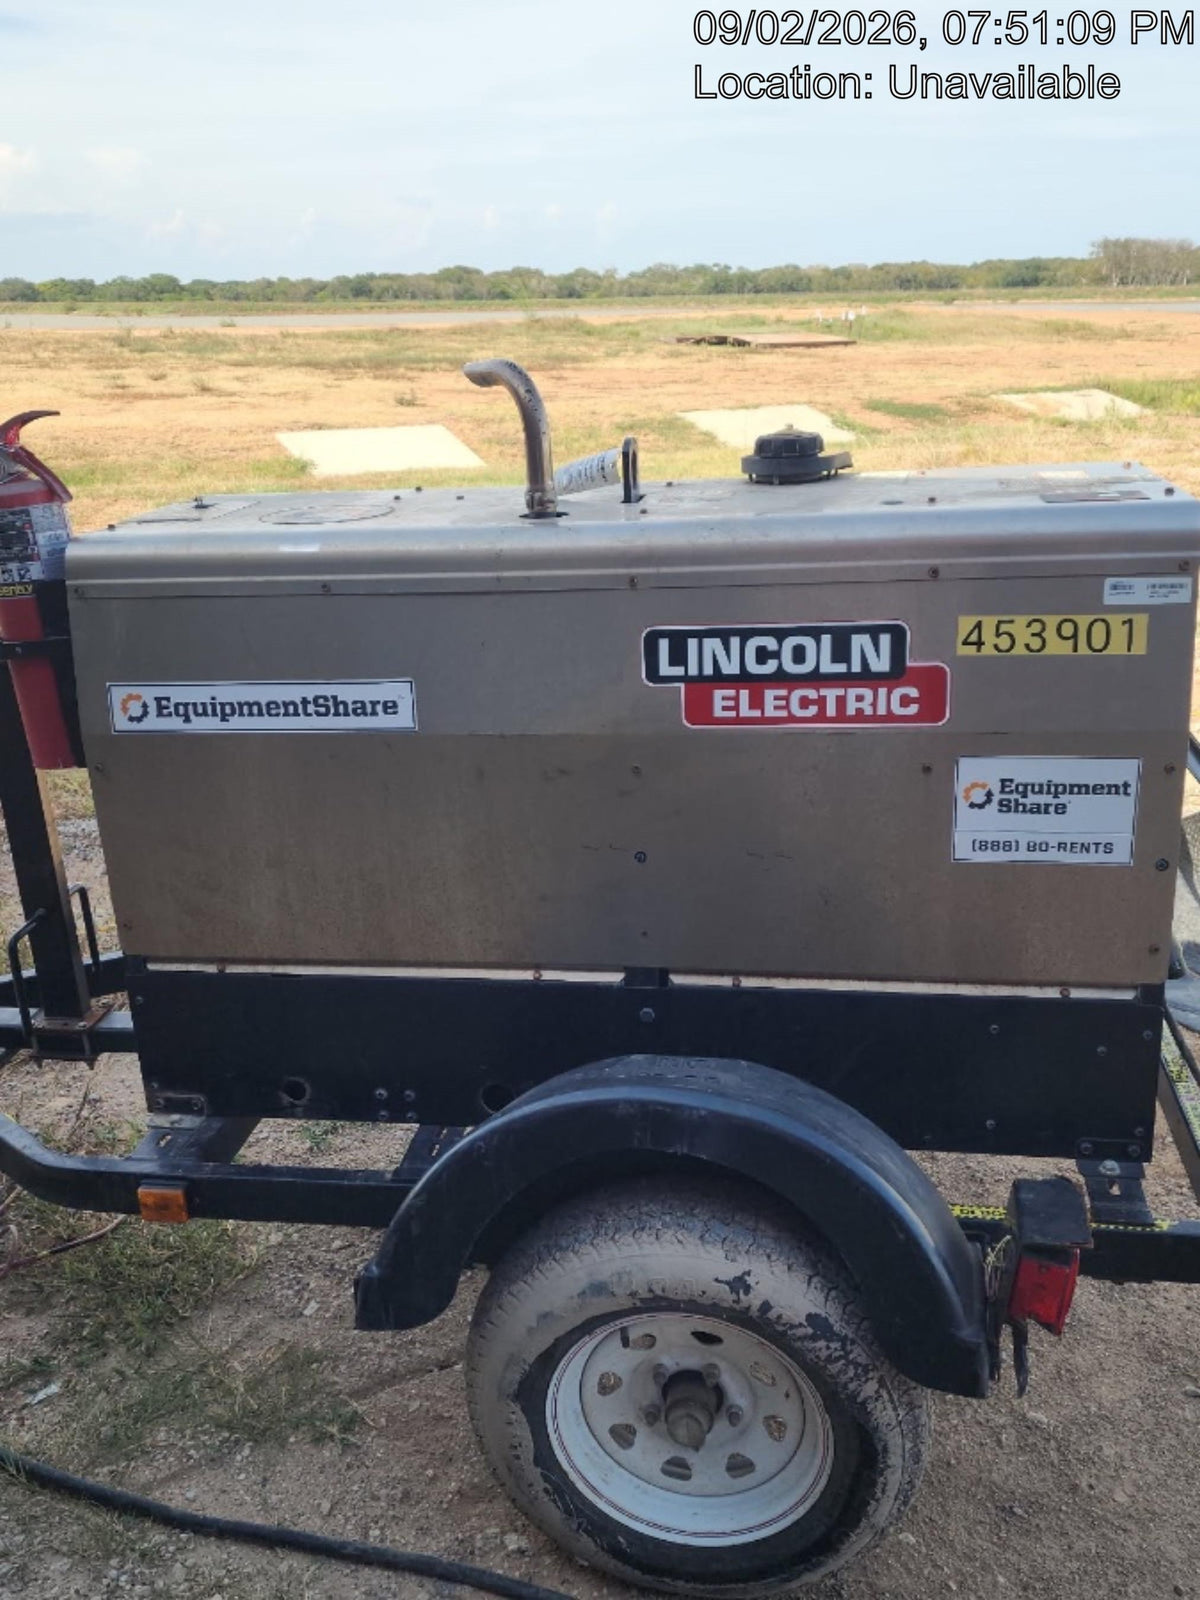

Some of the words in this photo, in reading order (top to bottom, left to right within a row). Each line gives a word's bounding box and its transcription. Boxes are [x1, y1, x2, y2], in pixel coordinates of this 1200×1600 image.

[961, 618, 1134, 654] 453901
[658, 633, 892, 677] LINCOLN
[154, 694, 399, 723] EquipmentShare
[712, 686, 920, 718] ELECTRIC
[999, 778, 1132, 799] Equipment
[997, 798, 1068, 815] Share
[971, 839, 1020, 853] (888)
